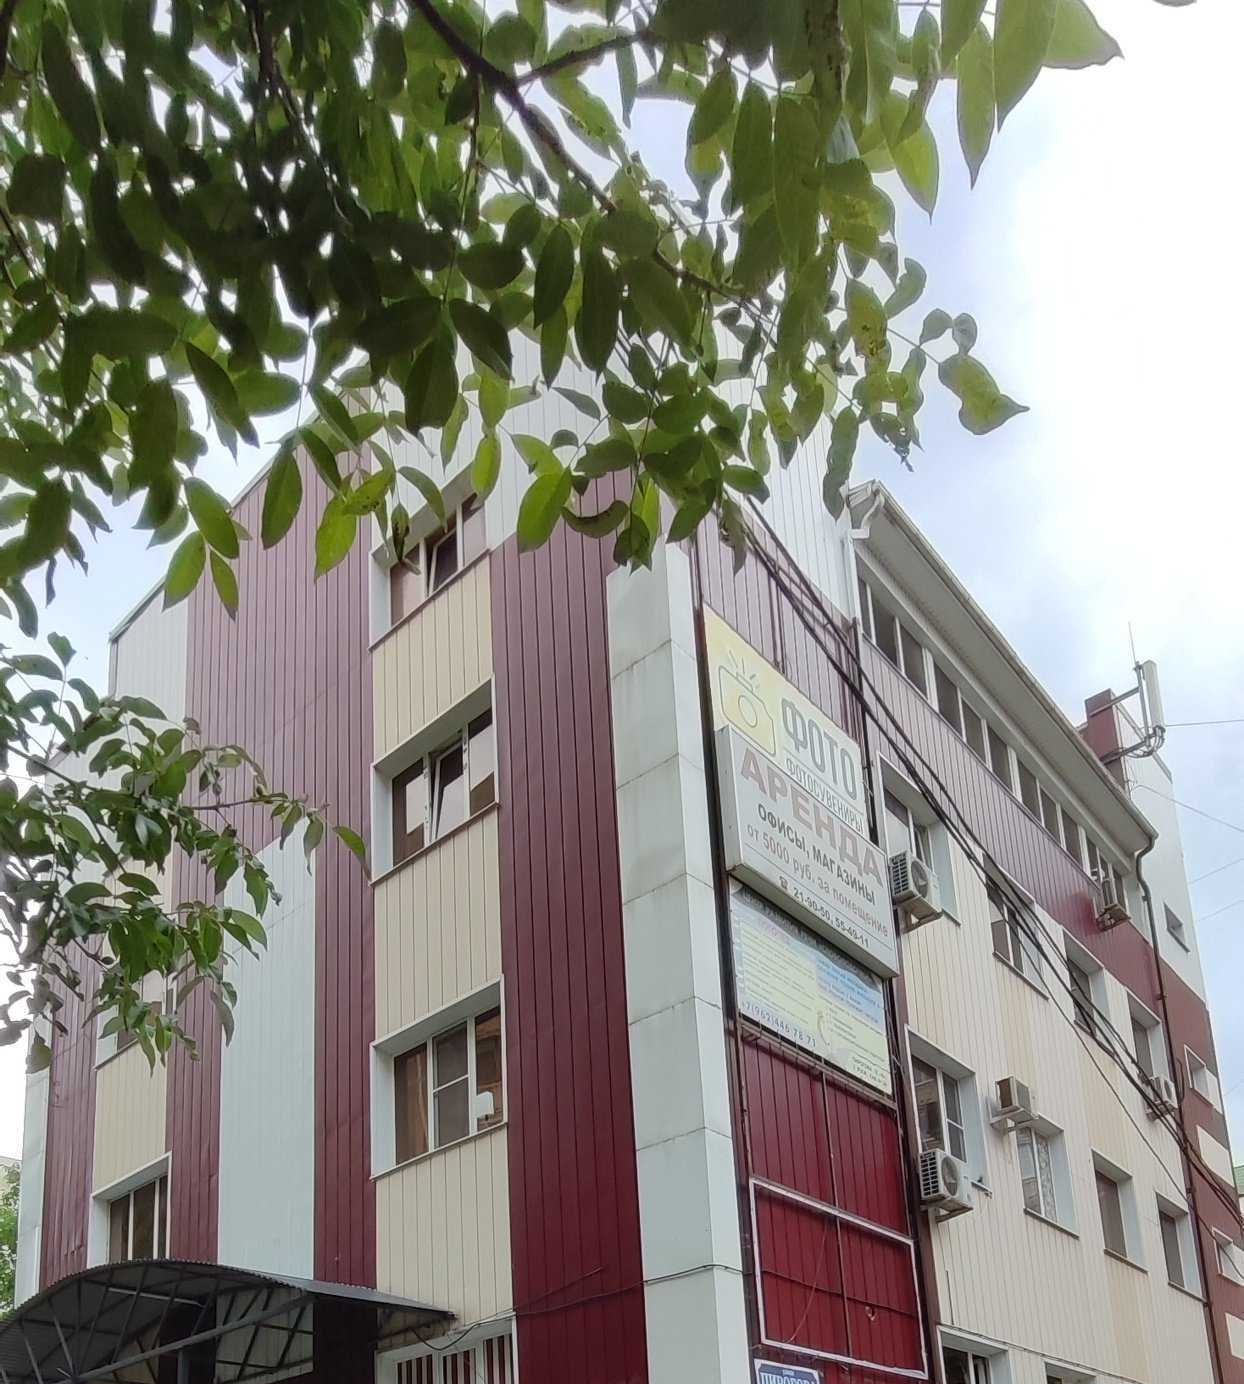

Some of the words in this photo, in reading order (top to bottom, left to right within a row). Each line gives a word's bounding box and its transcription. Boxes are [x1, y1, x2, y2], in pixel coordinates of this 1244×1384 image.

[781, 698, 857, 800] ФОТО
[786, 757, 865, 836] ФОТОСУВЕНИРЫ
[741, 747, 884, 888] АРЕНДА
[758, 804, 811, 859] ОФИСЫ,
[813, 845, 875, 905] МАГАЗИНЫ
[747, 825, 760, 842] от
[763, 834, 790, 865] 5000
[793, 857, 815, 884] руб.
[817, 874, 831, 893] за
[832, 887, 889, 938] помещение
